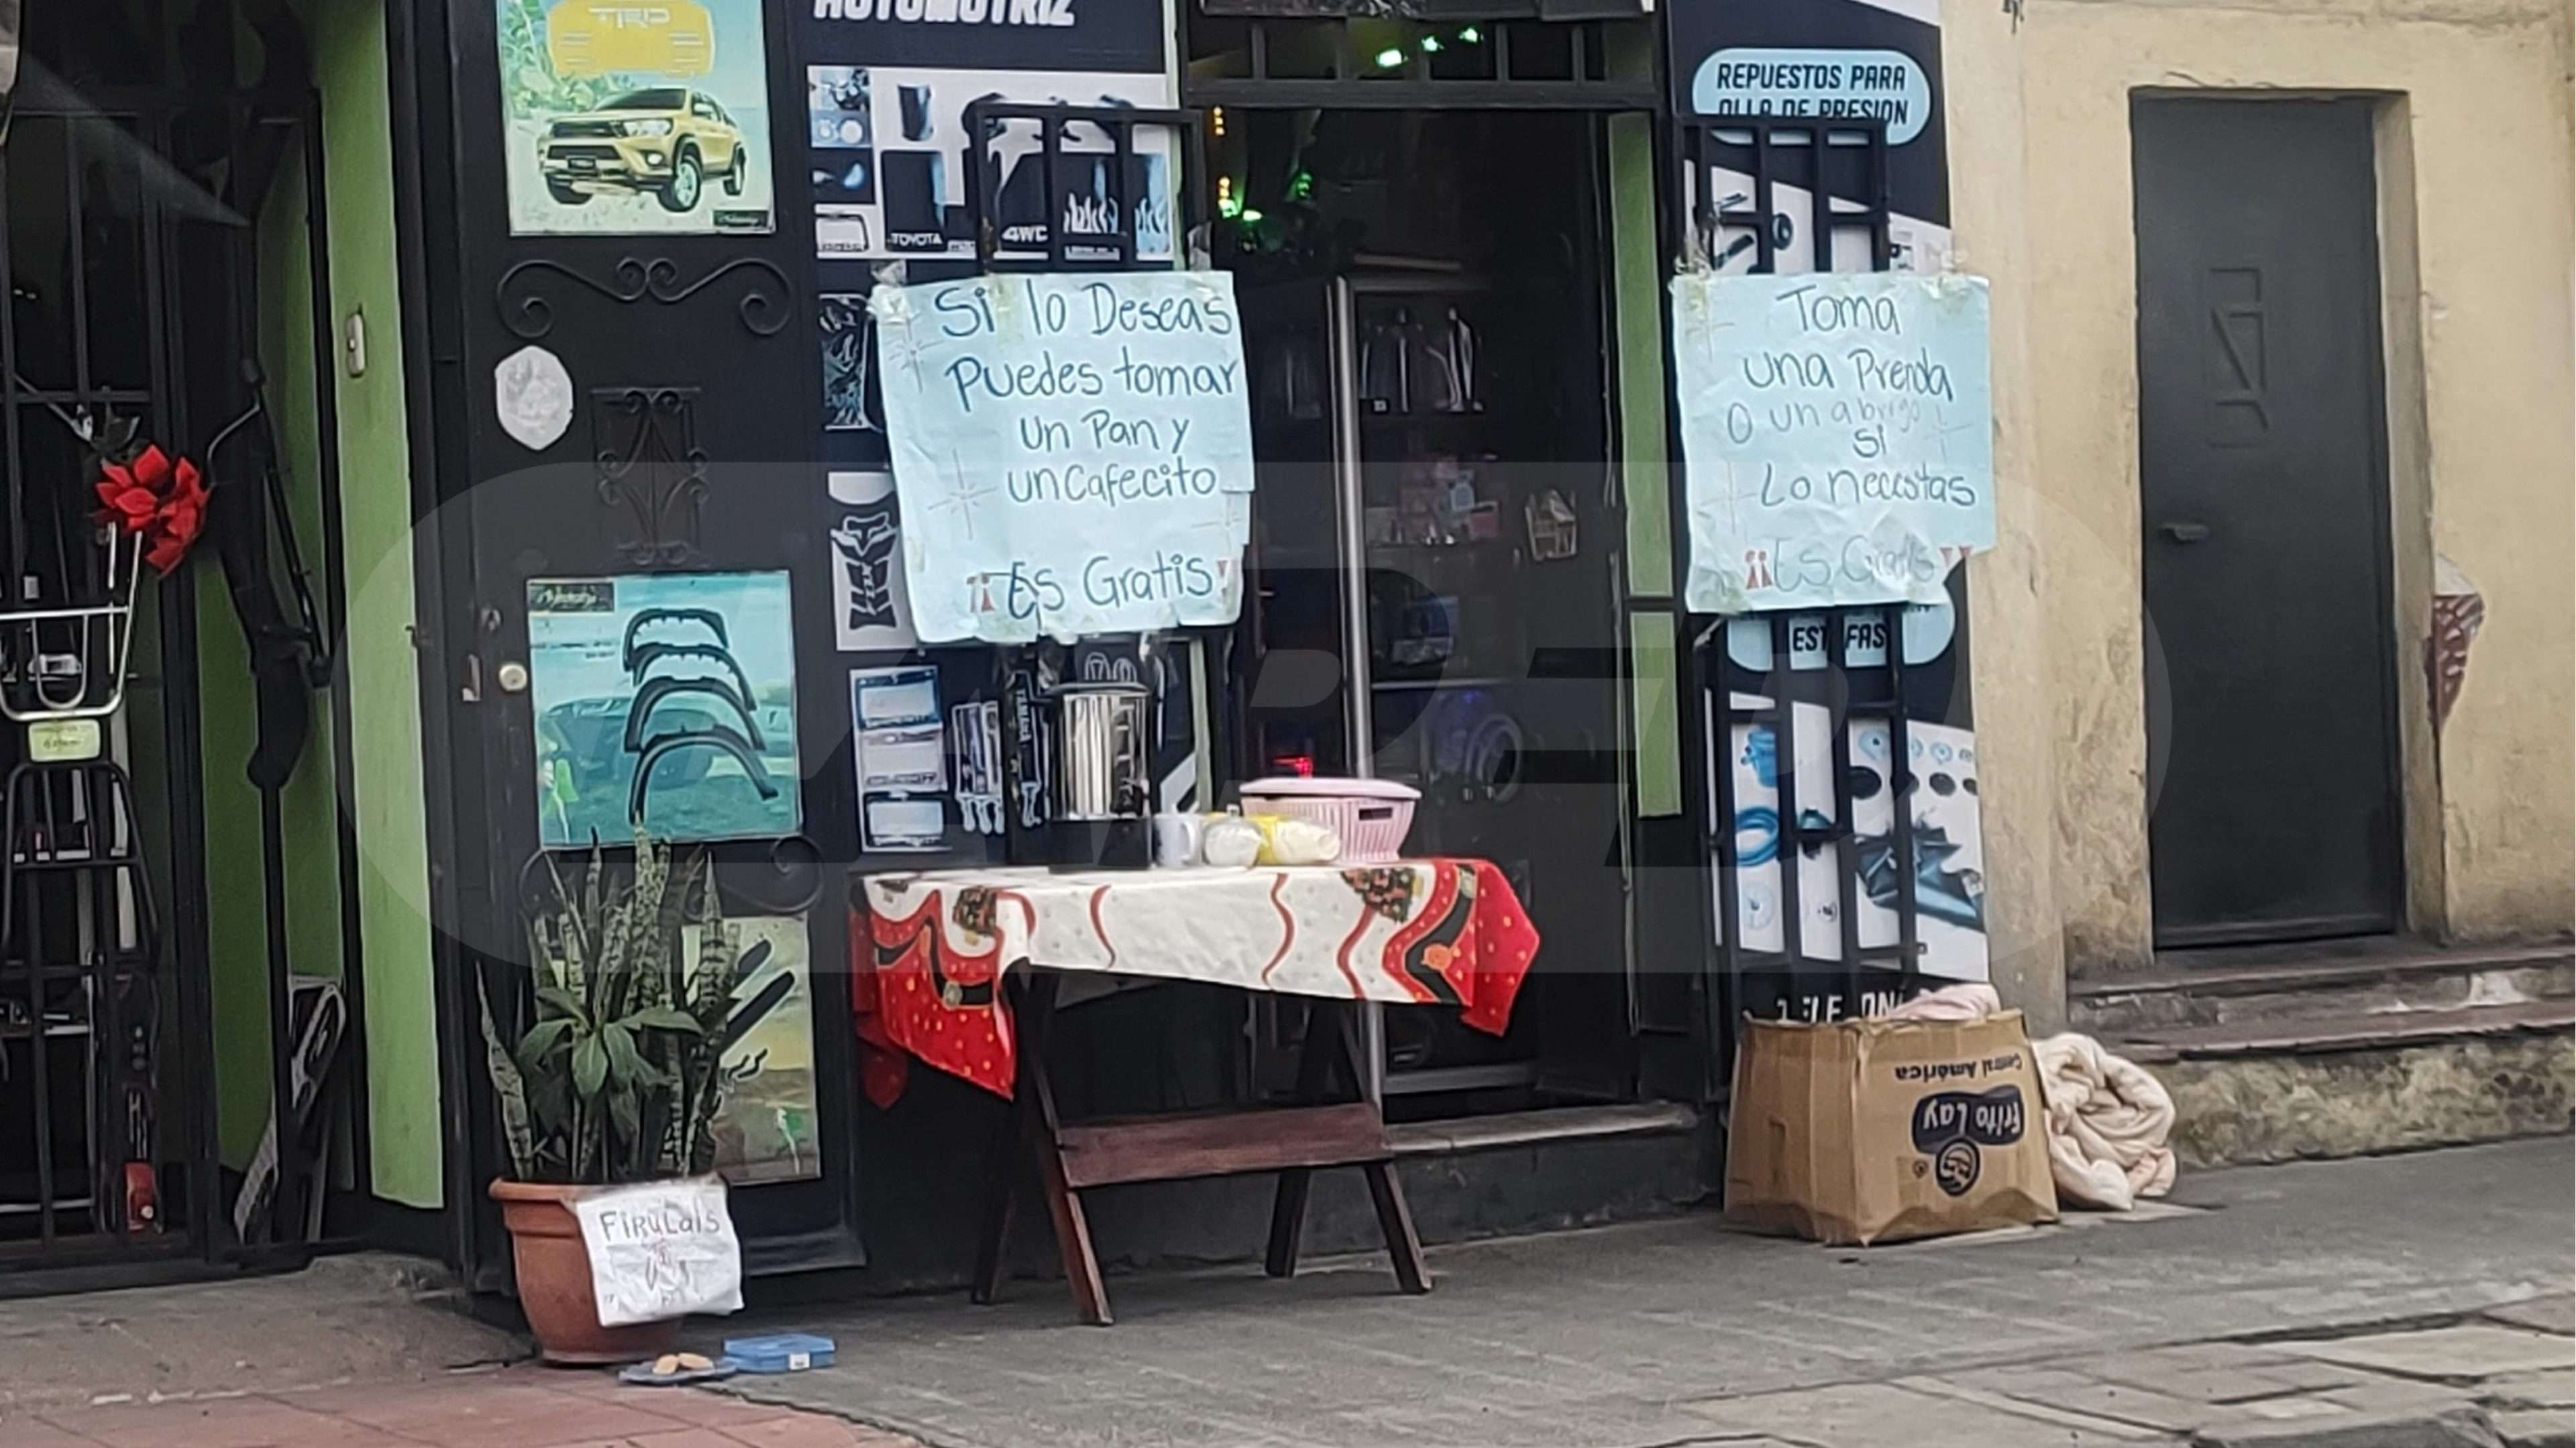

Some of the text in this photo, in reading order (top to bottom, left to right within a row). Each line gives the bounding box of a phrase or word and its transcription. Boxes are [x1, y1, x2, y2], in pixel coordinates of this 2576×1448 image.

[1717, 63, 1906, 91] REPUESTOS PARA
[890, 232, 943, 246] TOYOTA
[934, 286, 995, 336] Si
[1080, 282, 1233, 335] Deseas
[1776, 284, 1900, 335] Toma
[945, 346, 1239, 413] Puedes tomar
[1080, 409, 1160, 450] Pan
[1171, 419, 1190, 454] y
[1923, 1098, 2022, 1137] Frito Lay
